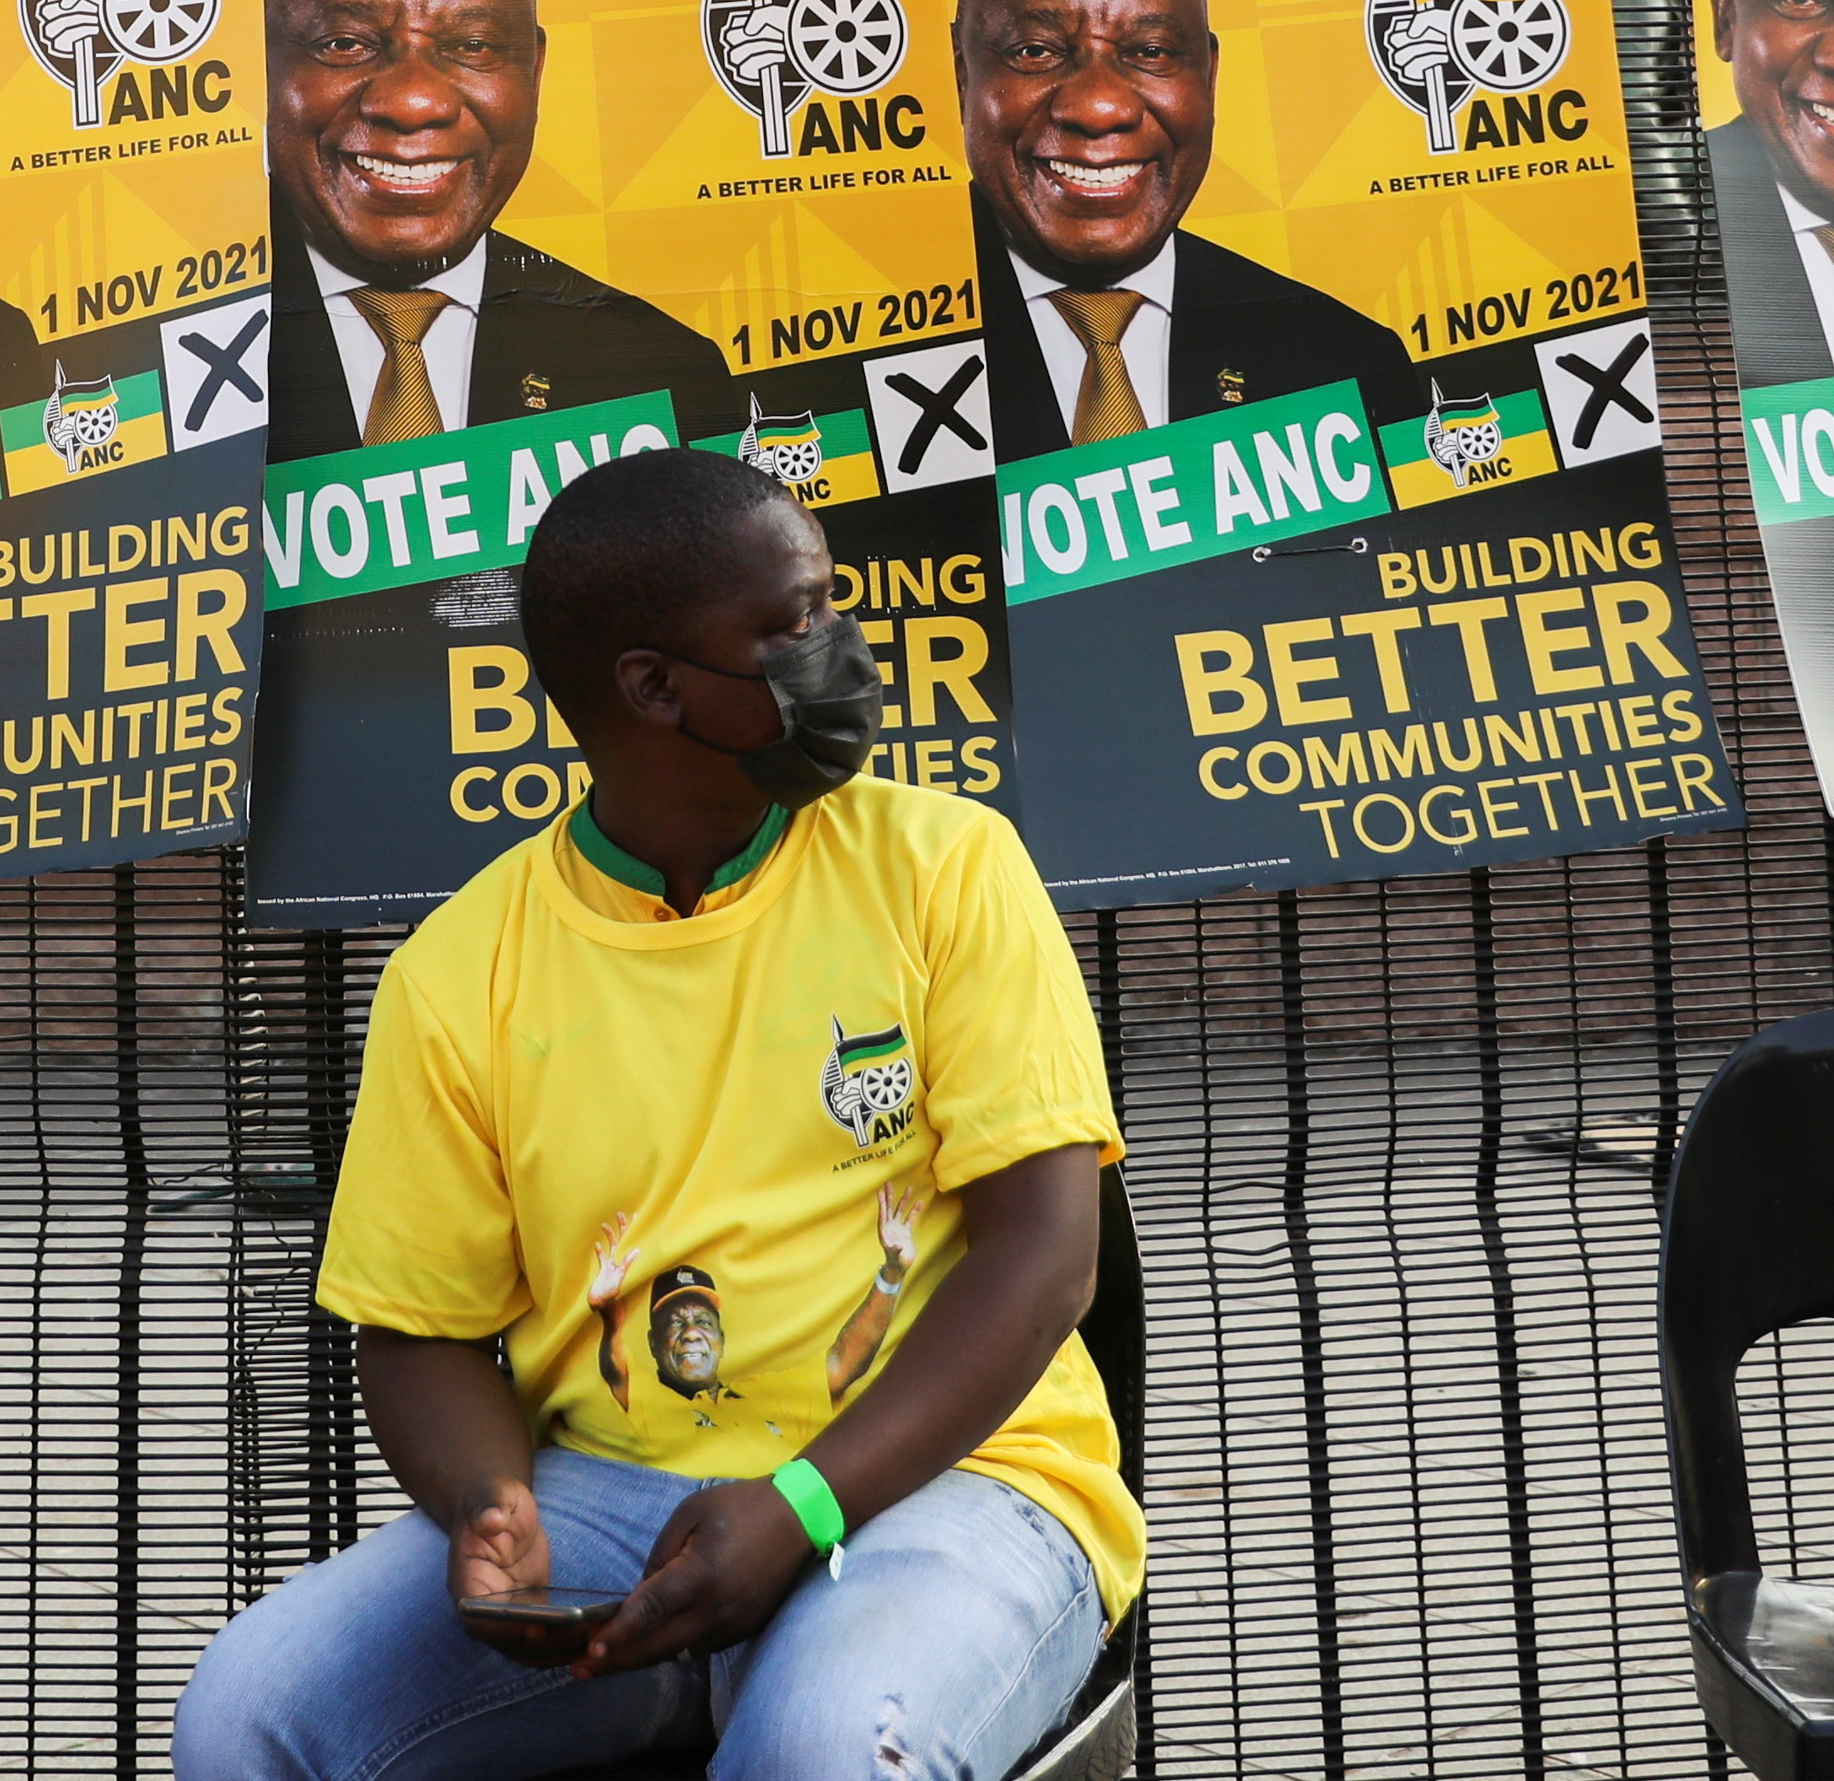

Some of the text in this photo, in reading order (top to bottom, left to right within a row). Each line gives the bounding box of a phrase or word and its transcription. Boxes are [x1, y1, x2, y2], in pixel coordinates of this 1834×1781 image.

[109, 60, 231, 125] ANC
[1465, 90, 1588, 151] ANC
[11, 127, 252, 171] A BETTER LIFE FOR ALL
[799, 95, 925, 156] ANC
[698, 166, 951, 199] A BETTER LIFE FOR ALL
[1370, 156, 1614, 194] A BETTER LIFE FOR ALL
[41, 235, 266, 333] 1 NOV 2021
[1412, 261, 1639, 352] 1 NOV 2021
[733, 279, 974, 365] 1 NOV 2021
[80, 442, 123, 470] ANC
[1212, 412, 1371, 535] ANC
[1469, 458, 1512, 485] ANC
[787, 479, 831, 503] NC
[830, 554, 986, 611] DING
[1377, 523, 1662, 598] BUILDING
[1175, 581, 1690, 736] BETTER
[1199, 690, 1702, 800] COMMUNITIES
[1299, 754, 1725, 858] TOGETHER
[873, 1100, 915, 1144] ANC
[832, 1164, 840, 1173] A
[840, 1152, 875, 1170] BETTER
[875, 1146, 894, 1159] LIFE
